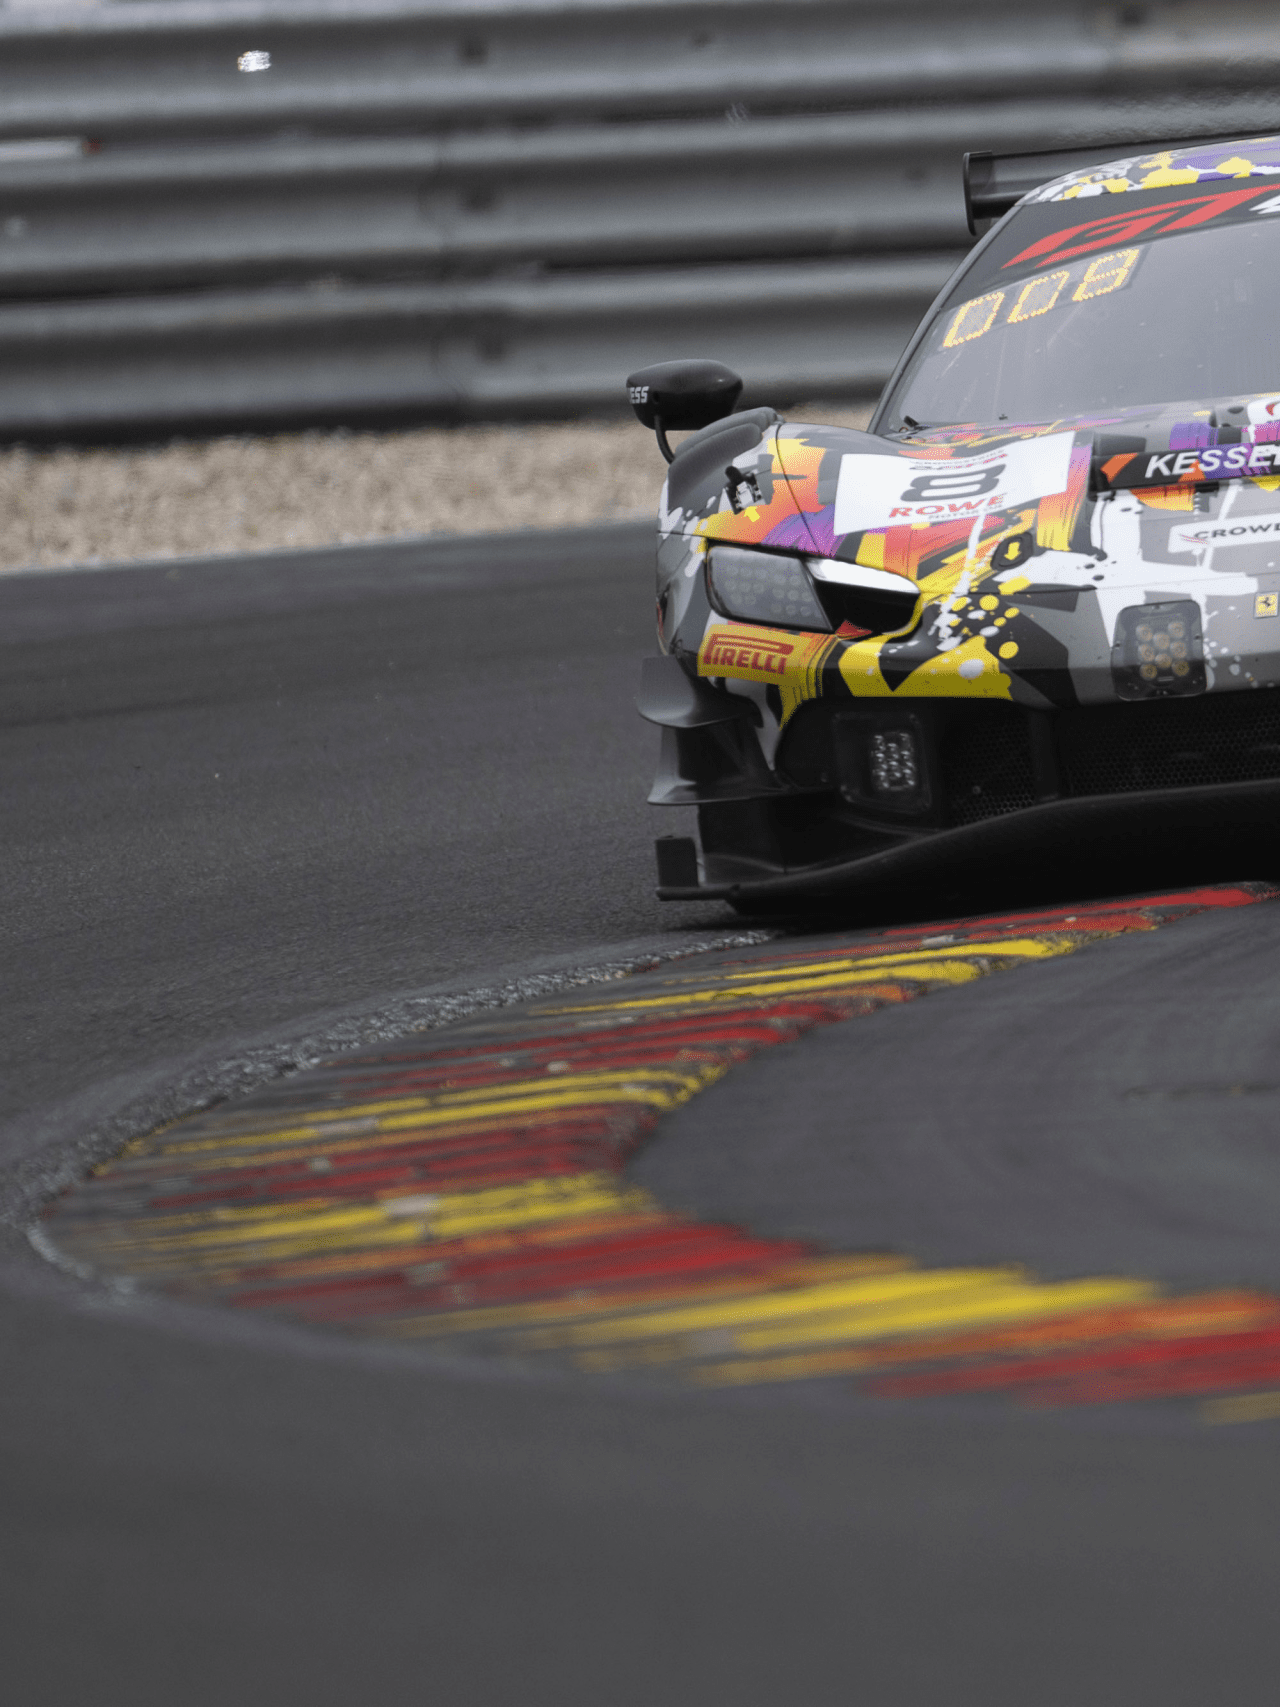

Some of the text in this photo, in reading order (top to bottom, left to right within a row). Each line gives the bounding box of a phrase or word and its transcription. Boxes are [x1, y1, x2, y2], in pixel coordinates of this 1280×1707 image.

[900, 464, 1006, 502] 8
[889, 495, 1005, 518] ROWE
[703, 633, 794, 674] PIRELLI
